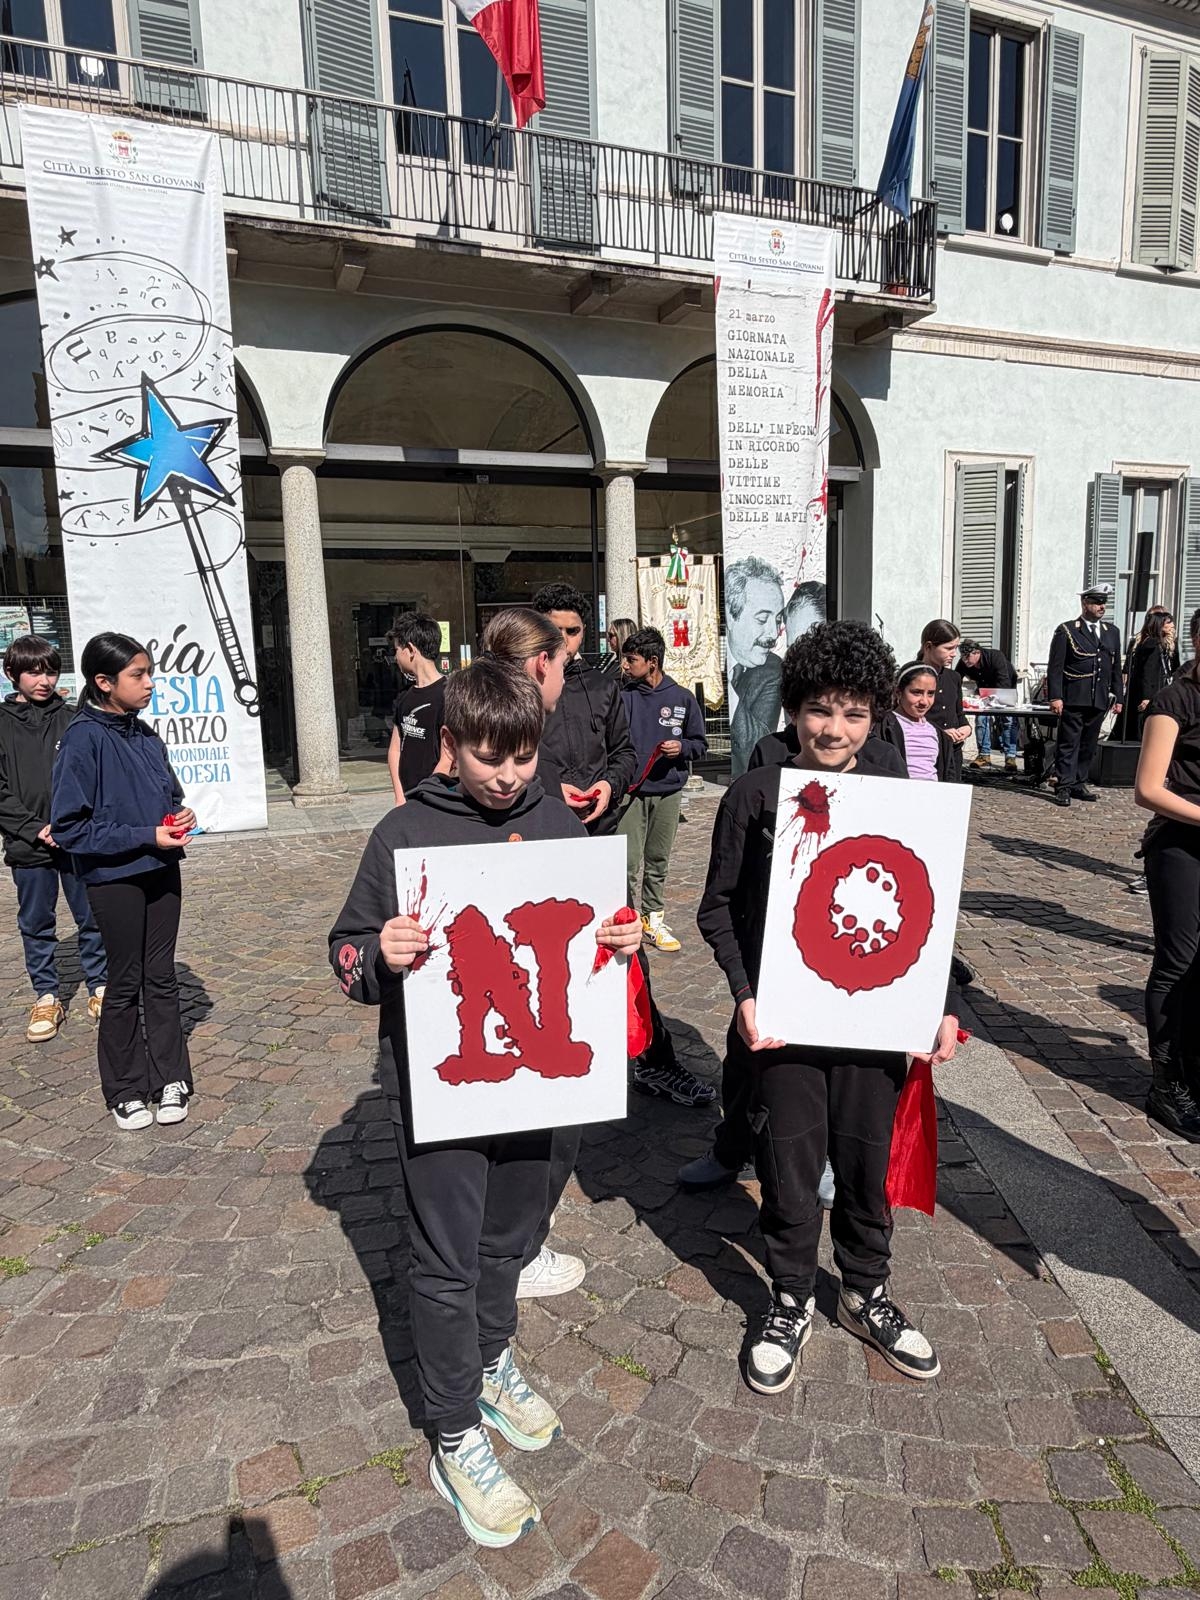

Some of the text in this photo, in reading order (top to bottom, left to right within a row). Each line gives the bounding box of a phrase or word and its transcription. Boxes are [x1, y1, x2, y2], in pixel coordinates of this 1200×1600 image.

[43, 159, 76, 173] CITTÀ
[79, 165, 91, 175] DI
[94, 166, 126, 179] SESTO
[129, 171, 149, 182] SAN
[152, 175, 205, 190] GIOVANNI
[779, 259, 792, 267] SAN
[792, 260, 824, 271] GIOVANNI
[728, 309, 776, 323] 21 marzo
[727, 329, 787, 345] GIORNATA
[727, 348, 795, 364] NAZIONALE
[727, 366, 768, 380] DELLA
[728, 385, 784, 398] MEMORIA
[728, 403, 737, 415] E
[727, 421, 764, 434] DELL'
[727, 439, 800, 453] IN RICORDO
[728, 457, 769, 470] DELLE
[728, 475, 781, 488] VITTIME
[728, 493, 793, 506] INNOCENTI
[728, 511, 769, 523] DELLE
[149, 675, 225, 716] ESIA
[169, 746, 231, 763] MONDIALE
[792, 833, 935, 996] O
[432, 896, 595, 1087] N
